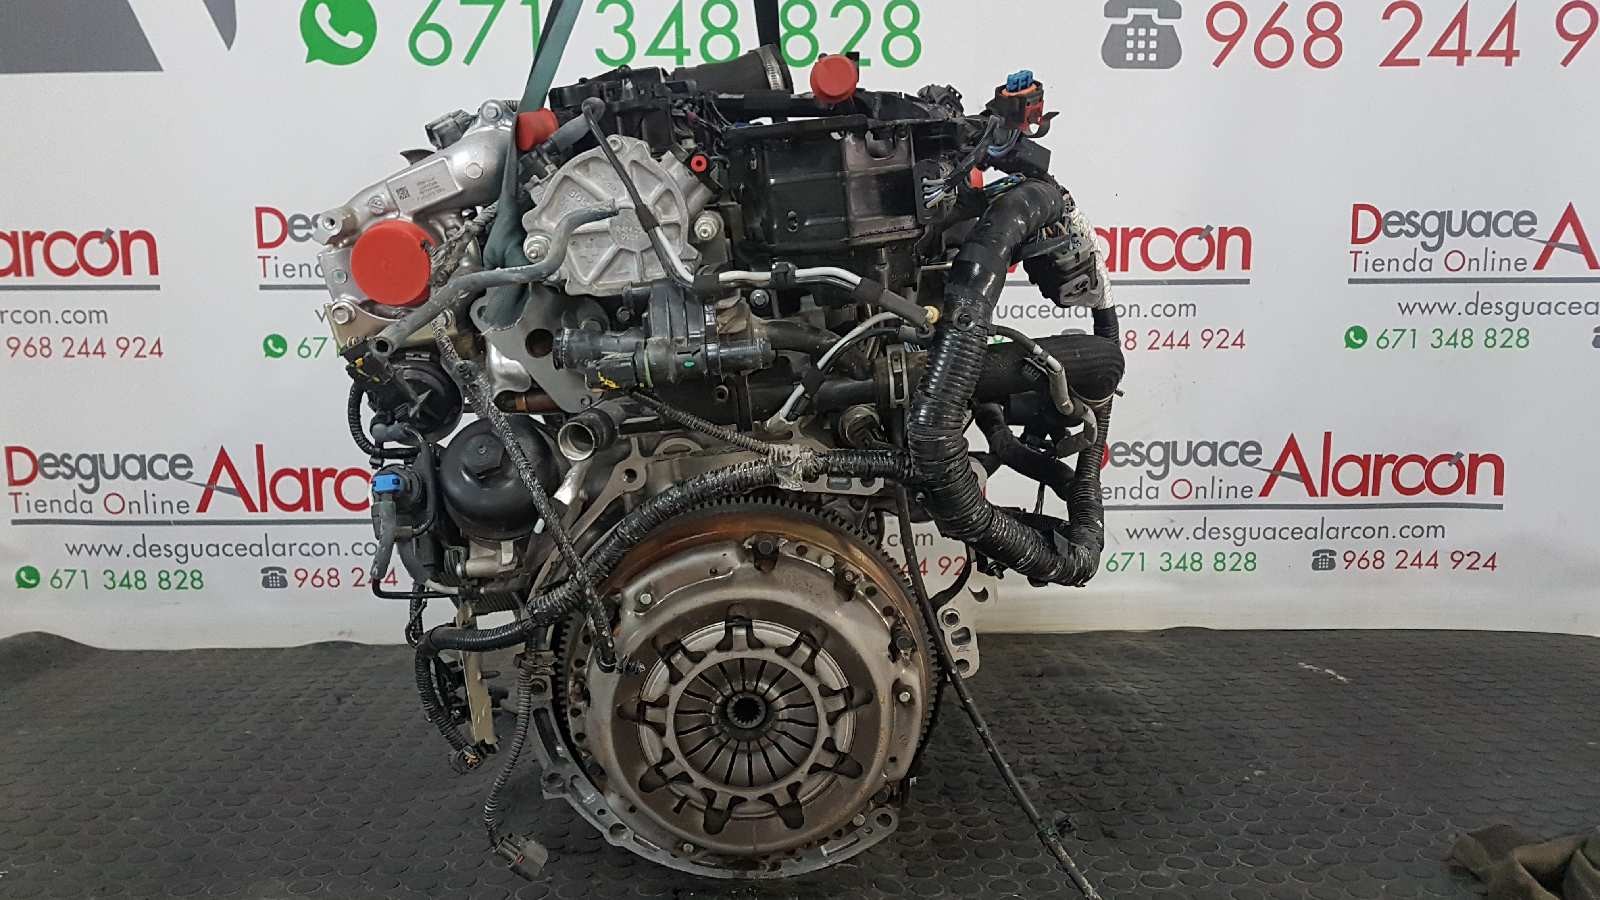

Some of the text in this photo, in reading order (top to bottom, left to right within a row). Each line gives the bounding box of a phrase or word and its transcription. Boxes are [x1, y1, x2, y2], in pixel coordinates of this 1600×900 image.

[408, 0, 922, 68] 671 348 828
[1205, 0, 1599, 68] 968 244 9
[1351, 202, 1600, 271] Desguace A
[1350, 247, 1528, 272] Tienda Online
[1398, 291, 1600, 322] www.desguacea
[6, 336, 163, 358] 968 244 924
[1147, 329, 1190, 350] 244
[1200, 328, 1246, 349] 924
[1376, 328, 1530, 349] 671 348 828
[5, 443, 373, 513] Desguace Alarc
[1171, 475, 1253, 500] Online
[8, 489, 190, 515] Tienda Online
[1125, 516, 1446, 547] www.desguacealarcon.com
[65, 533, 378, 565] www.desguacealarcon.co
[1343, 550, 1497, 572] 968 244 924
[1105, 551, 1257, 573] 671 348 828
[50, 569, 204, 590] 671 348 828
[294, 567, 340, 588] 968
